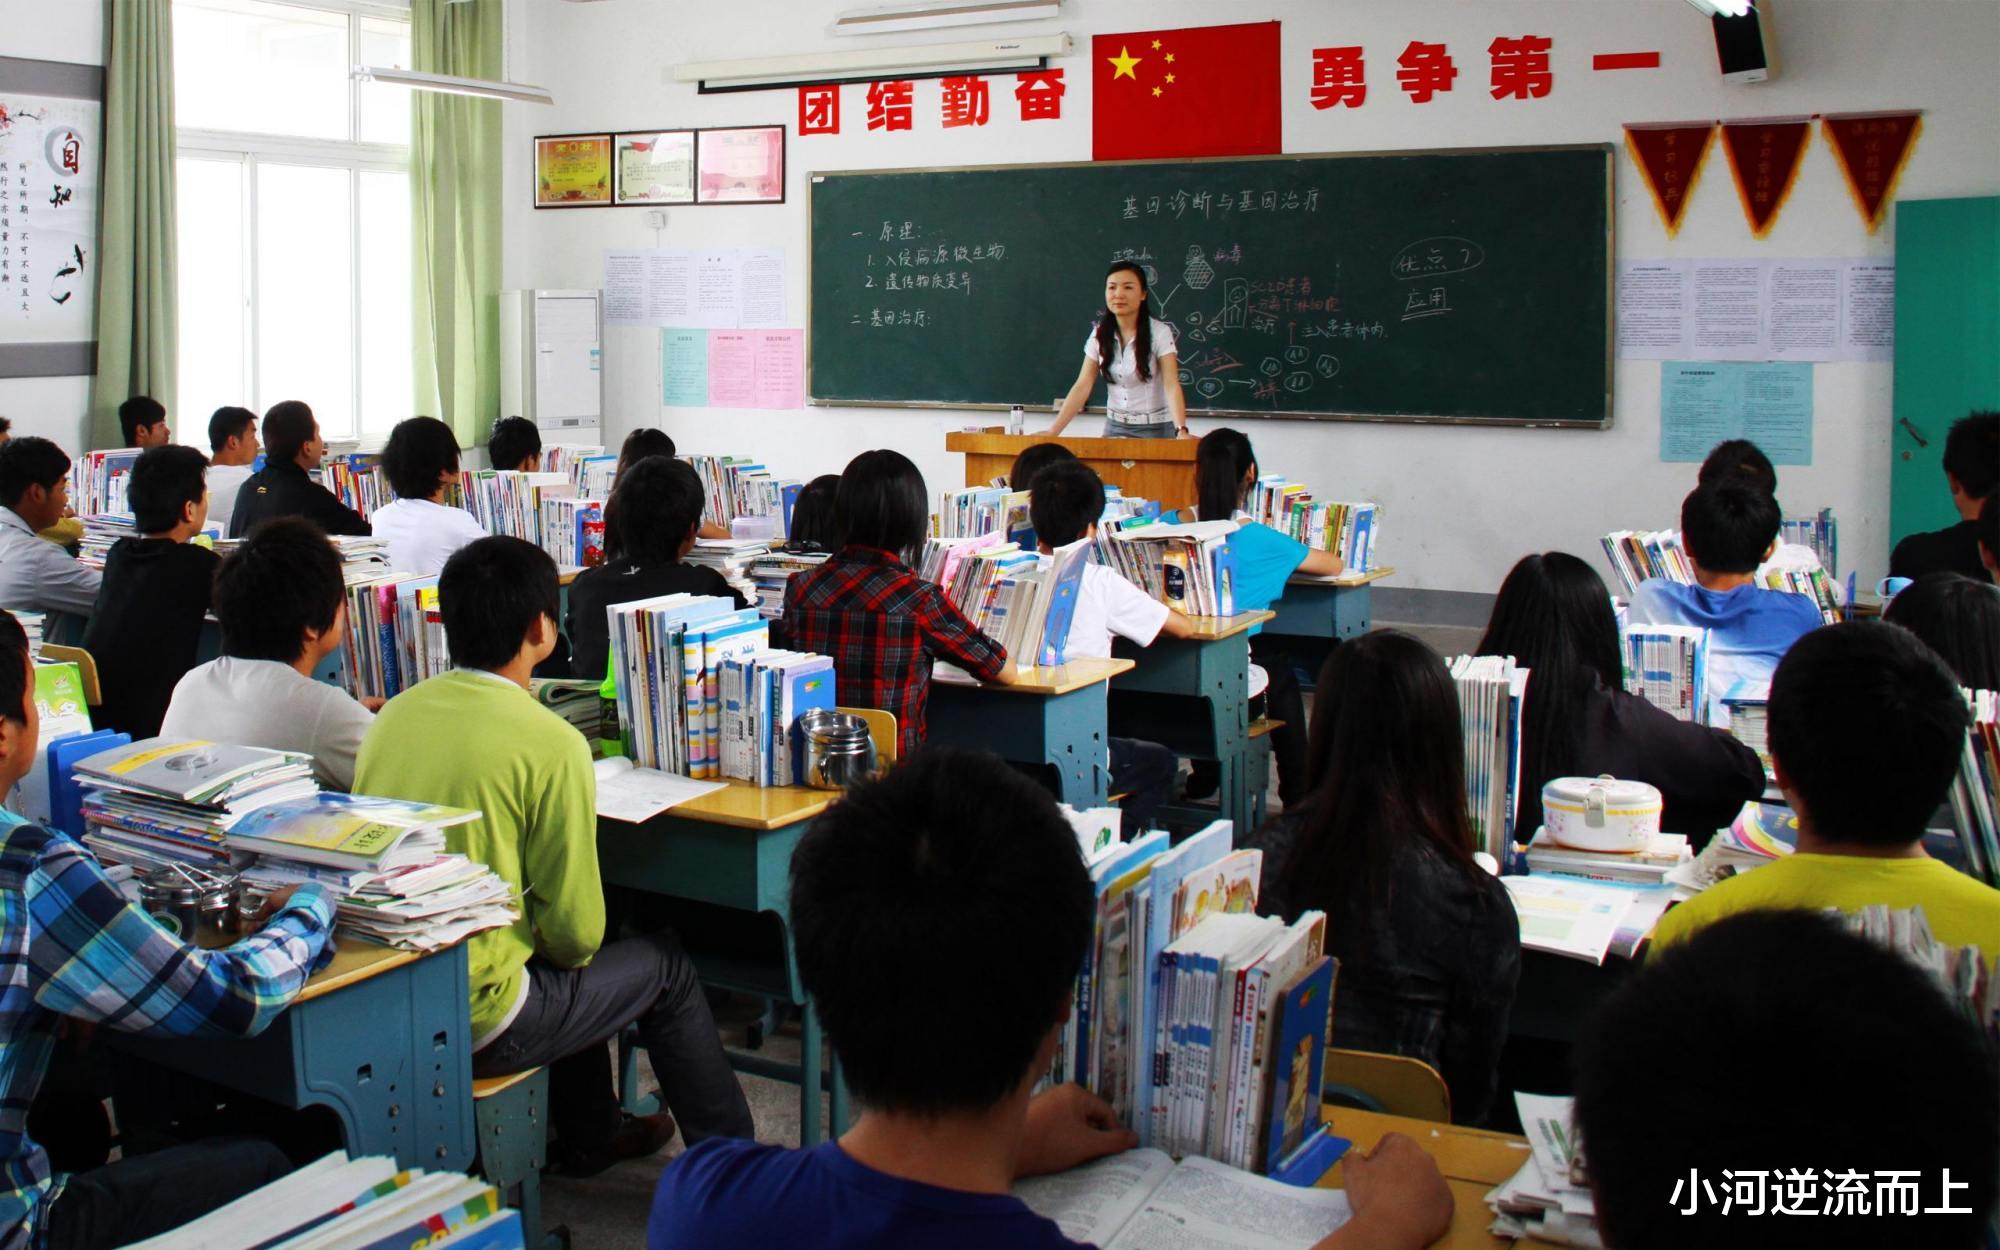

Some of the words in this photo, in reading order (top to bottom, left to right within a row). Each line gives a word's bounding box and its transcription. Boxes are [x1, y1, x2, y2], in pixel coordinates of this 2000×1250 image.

[1310, 35, 1660, 110] 勇争第一
[798, 68, 1066, 136] 团结勤奋
[1123, 188, 1320, 220] 基因诊断与基因治疗
[1405, 288, 1447, 312] 应用
